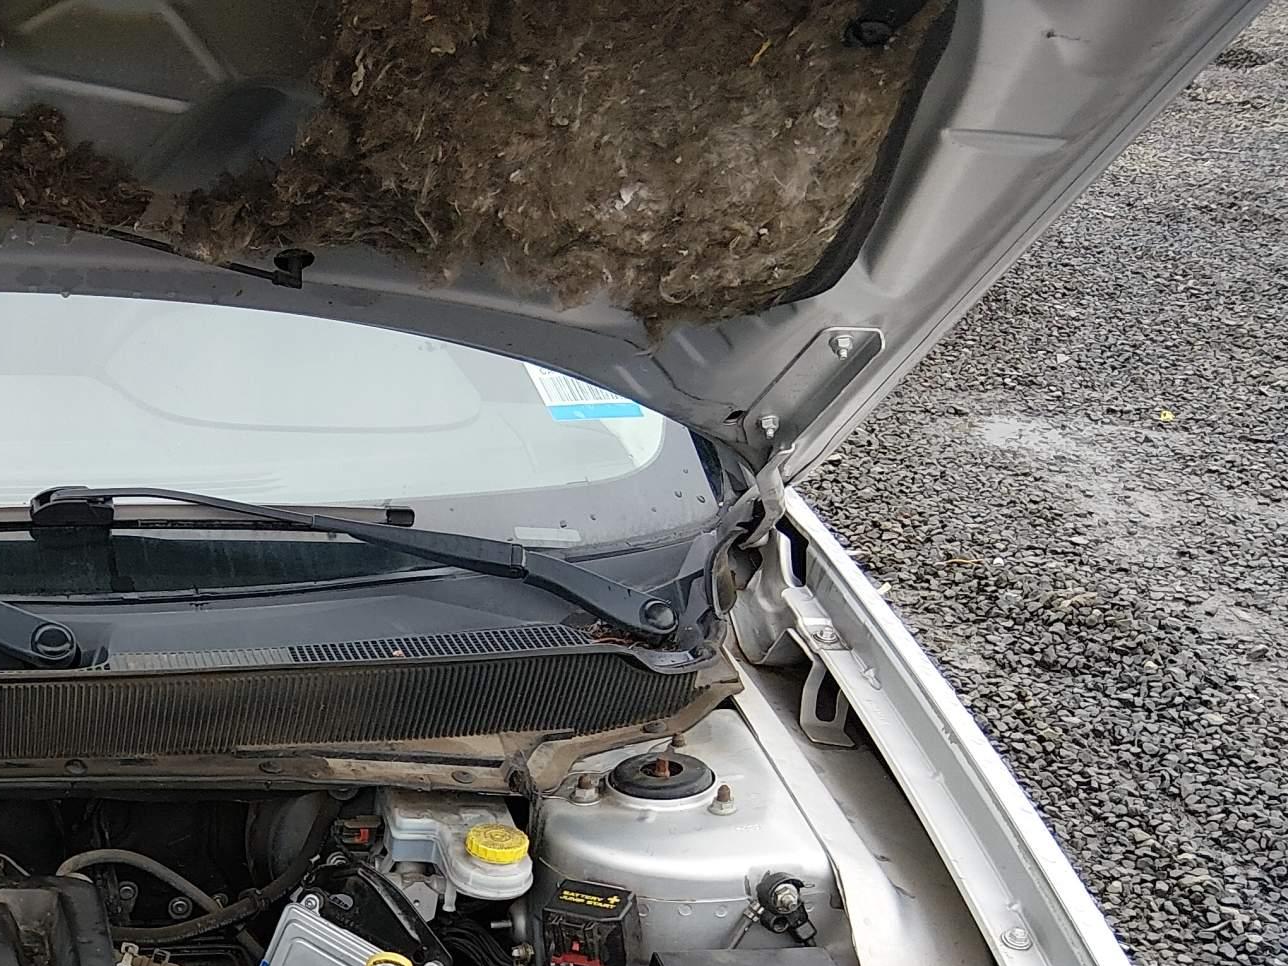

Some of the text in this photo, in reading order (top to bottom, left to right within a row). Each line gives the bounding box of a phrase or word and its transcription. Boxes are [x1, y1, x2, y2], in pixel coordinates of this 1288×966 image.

[559, 895, 617, 909] JUMP START
[562, 890, 603, 902] BATTERY
